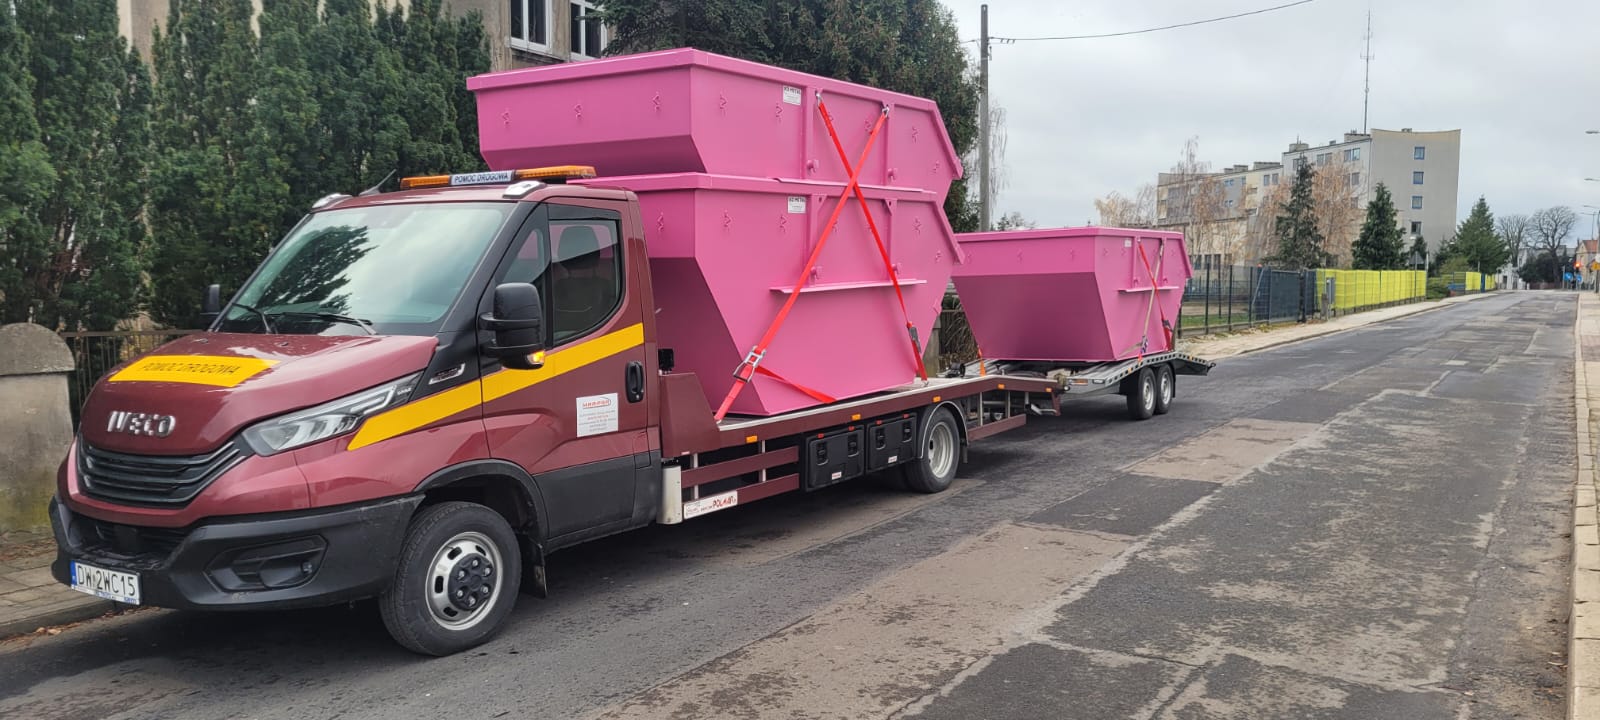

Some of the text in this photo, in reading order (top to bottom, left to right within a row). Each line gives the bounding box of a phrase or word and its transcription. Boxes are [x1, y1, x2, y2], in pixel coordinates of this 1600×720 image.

[455, 172, 509, 183] POMOC DROGOWA
[141, 363, 241, 376] POMOC DROGOWA
[107, 411, 176, 437] IVECO
[77, 565, 92, 588] DW
[95, 570, 136, 596] 2WC15
